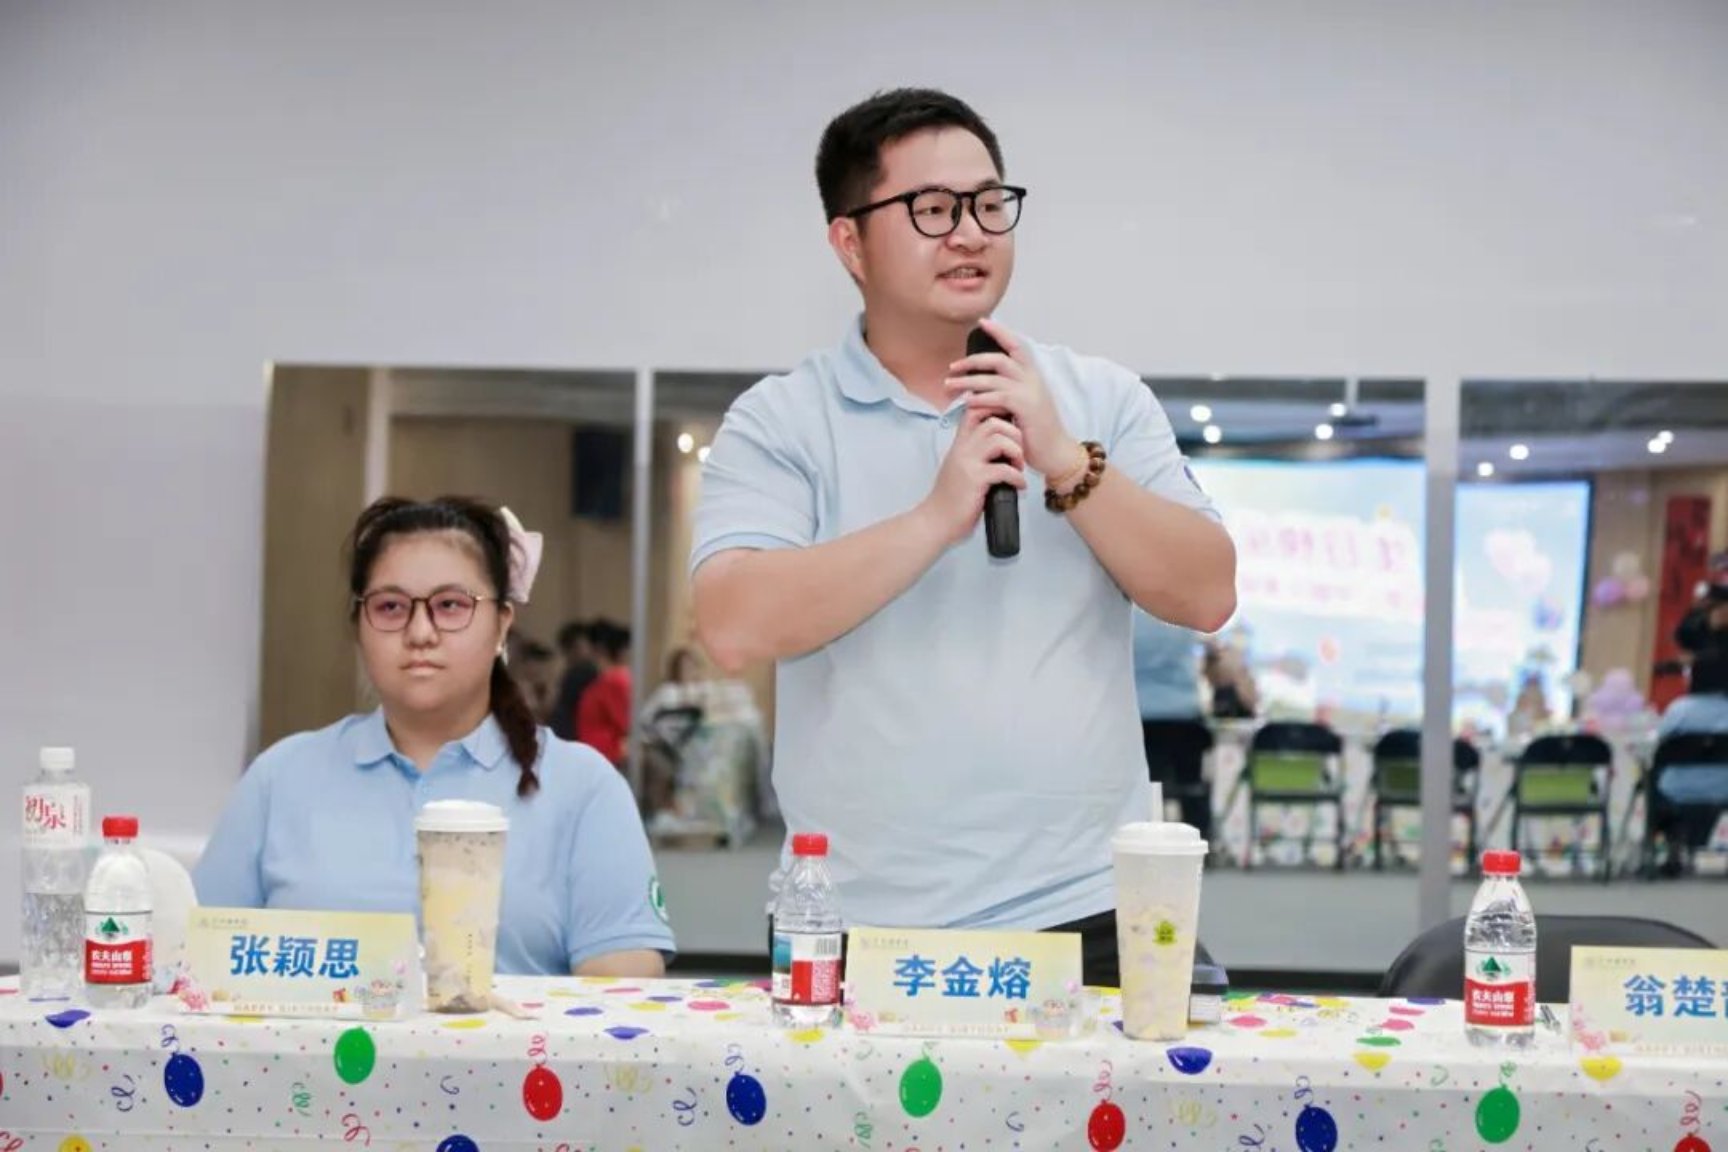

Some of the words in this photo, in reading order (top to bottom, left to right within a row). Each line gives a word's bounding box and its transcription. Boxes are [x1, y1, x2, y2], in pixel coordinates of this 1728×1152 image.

[230, 935, 360, 978] 张颖思
[893, 954, 1031, 999] 李金熔
[1623, 975, 1728, 1019] 翁楚
